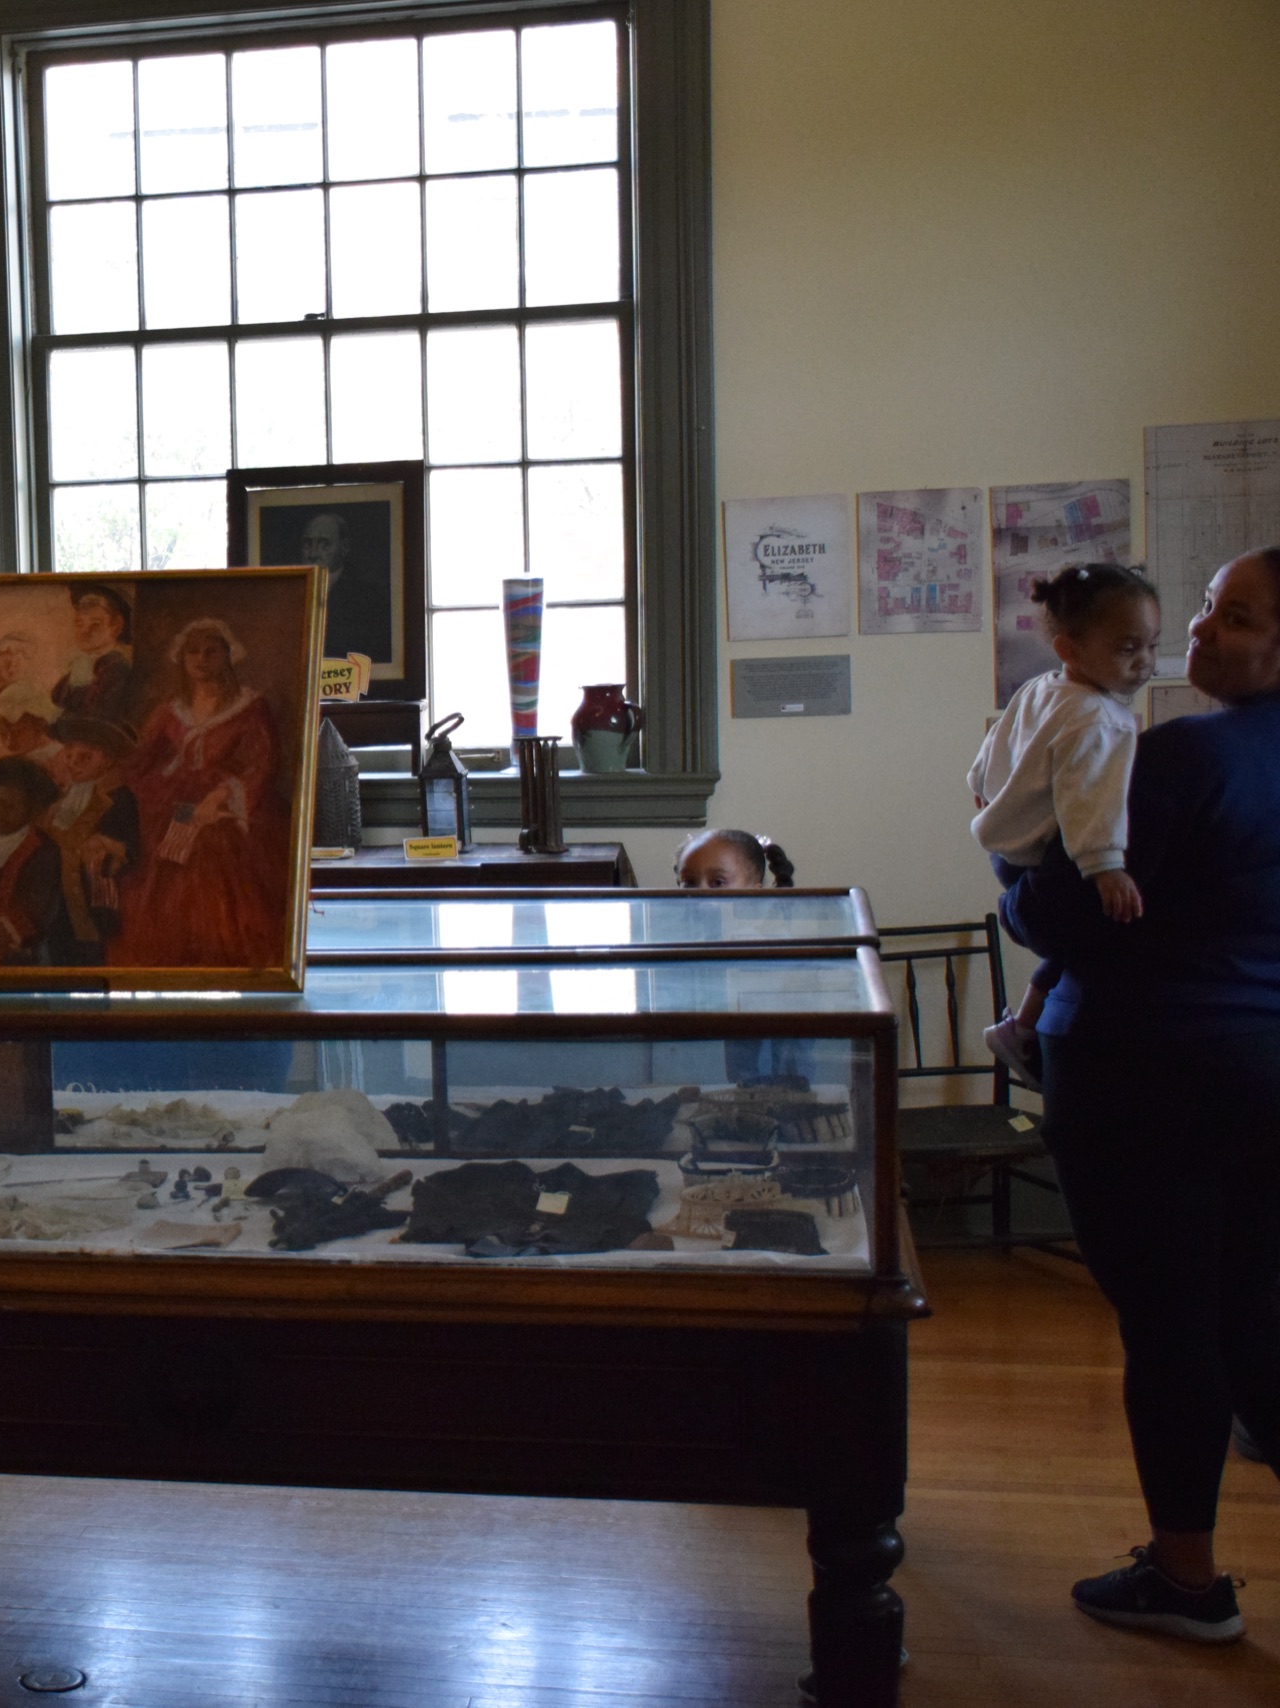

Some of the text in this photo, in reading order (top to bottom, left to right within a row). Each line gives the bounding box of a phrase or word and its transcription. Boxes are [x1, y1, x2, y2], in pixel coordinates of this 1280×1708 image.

[763, 543, 826, 557] ELIZABETH
[320, 667, 353, 680] ersey
[321, 682, 352, 696] ORY
